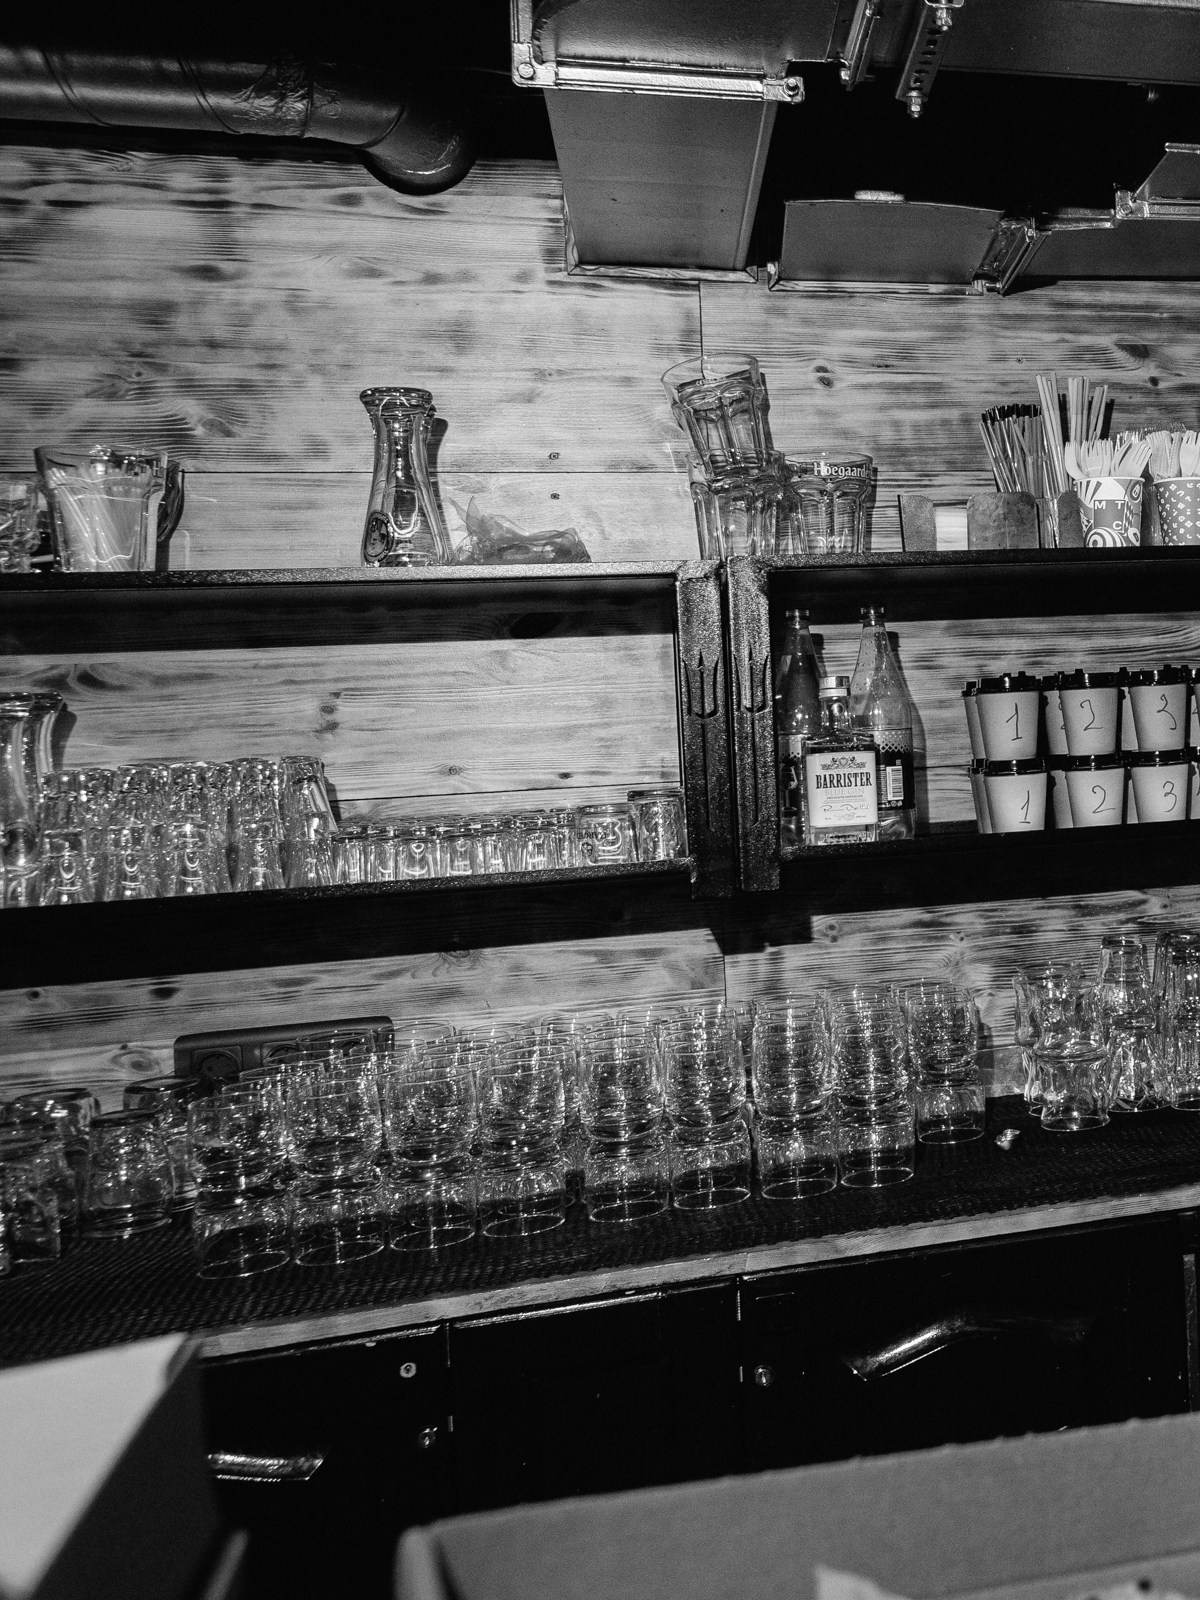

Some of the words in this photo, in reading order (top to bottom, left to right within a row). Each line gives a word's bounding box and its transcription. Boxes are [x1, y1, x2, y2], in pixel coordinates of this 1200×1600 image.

[1005, 702, 1023, 741] 1
[1080, 699, 1104, 732] 2
[1156, 693, 1177, 730] 3
[815, 771, 872, 789] BARRISTER
[825, 788, 845, 796] BLUE
[847, 787, 865, 795] GIN
[1162, 780, 1178, 813] 3
[1019, 790, 1031, 824] 1
[1092, 784, 1116, 814] 2
